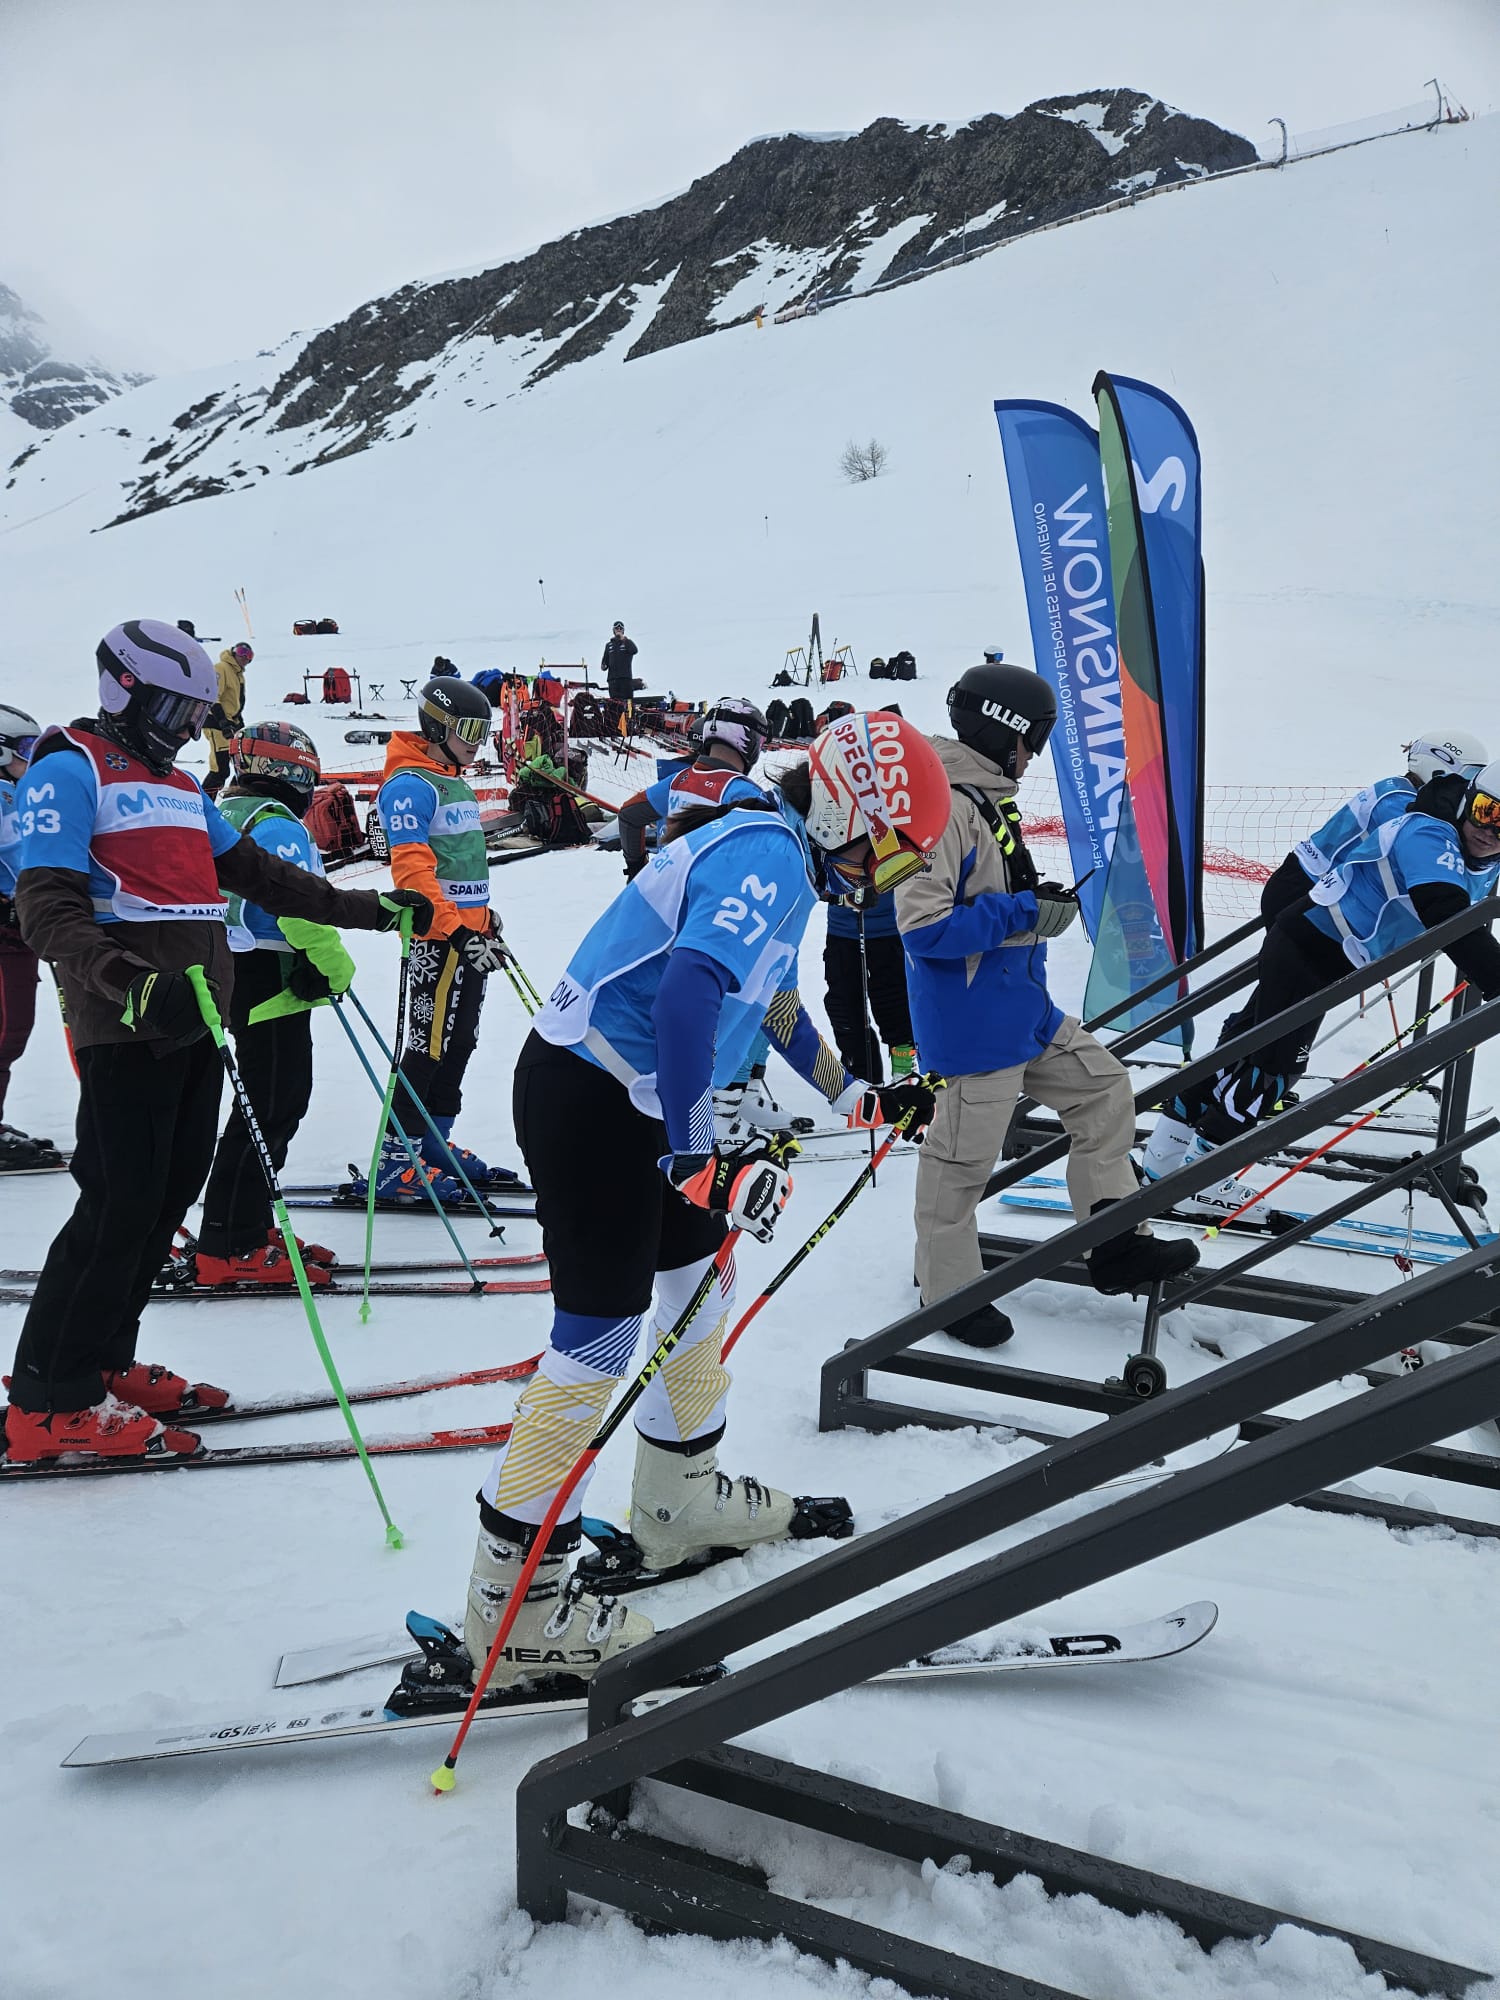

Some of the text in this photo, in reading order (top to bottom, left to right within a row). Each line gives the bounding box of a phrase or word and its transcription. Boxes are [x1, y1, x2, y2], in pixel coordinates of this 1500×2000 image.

[981, 699, 1031, 735] ULLER
[834, 723, 880, 798] SPECT
[869, 720, 912, 825] ROSSI
[21, 808, 61, 837] 33
[390, 814, 418, 831] 80
[712, 896, 768, 946] 27
[232, 1069, 281, 1191] KOMPERDELL
[716, 1161, 730, 1188] EKI
[751, 1173, 774, 1216] reusch
[1191, 1194, 1242, 1211] EAD
[806, 1214, 838, 1252] LEKI
[639, 1331, 678, 1387] LEKI
